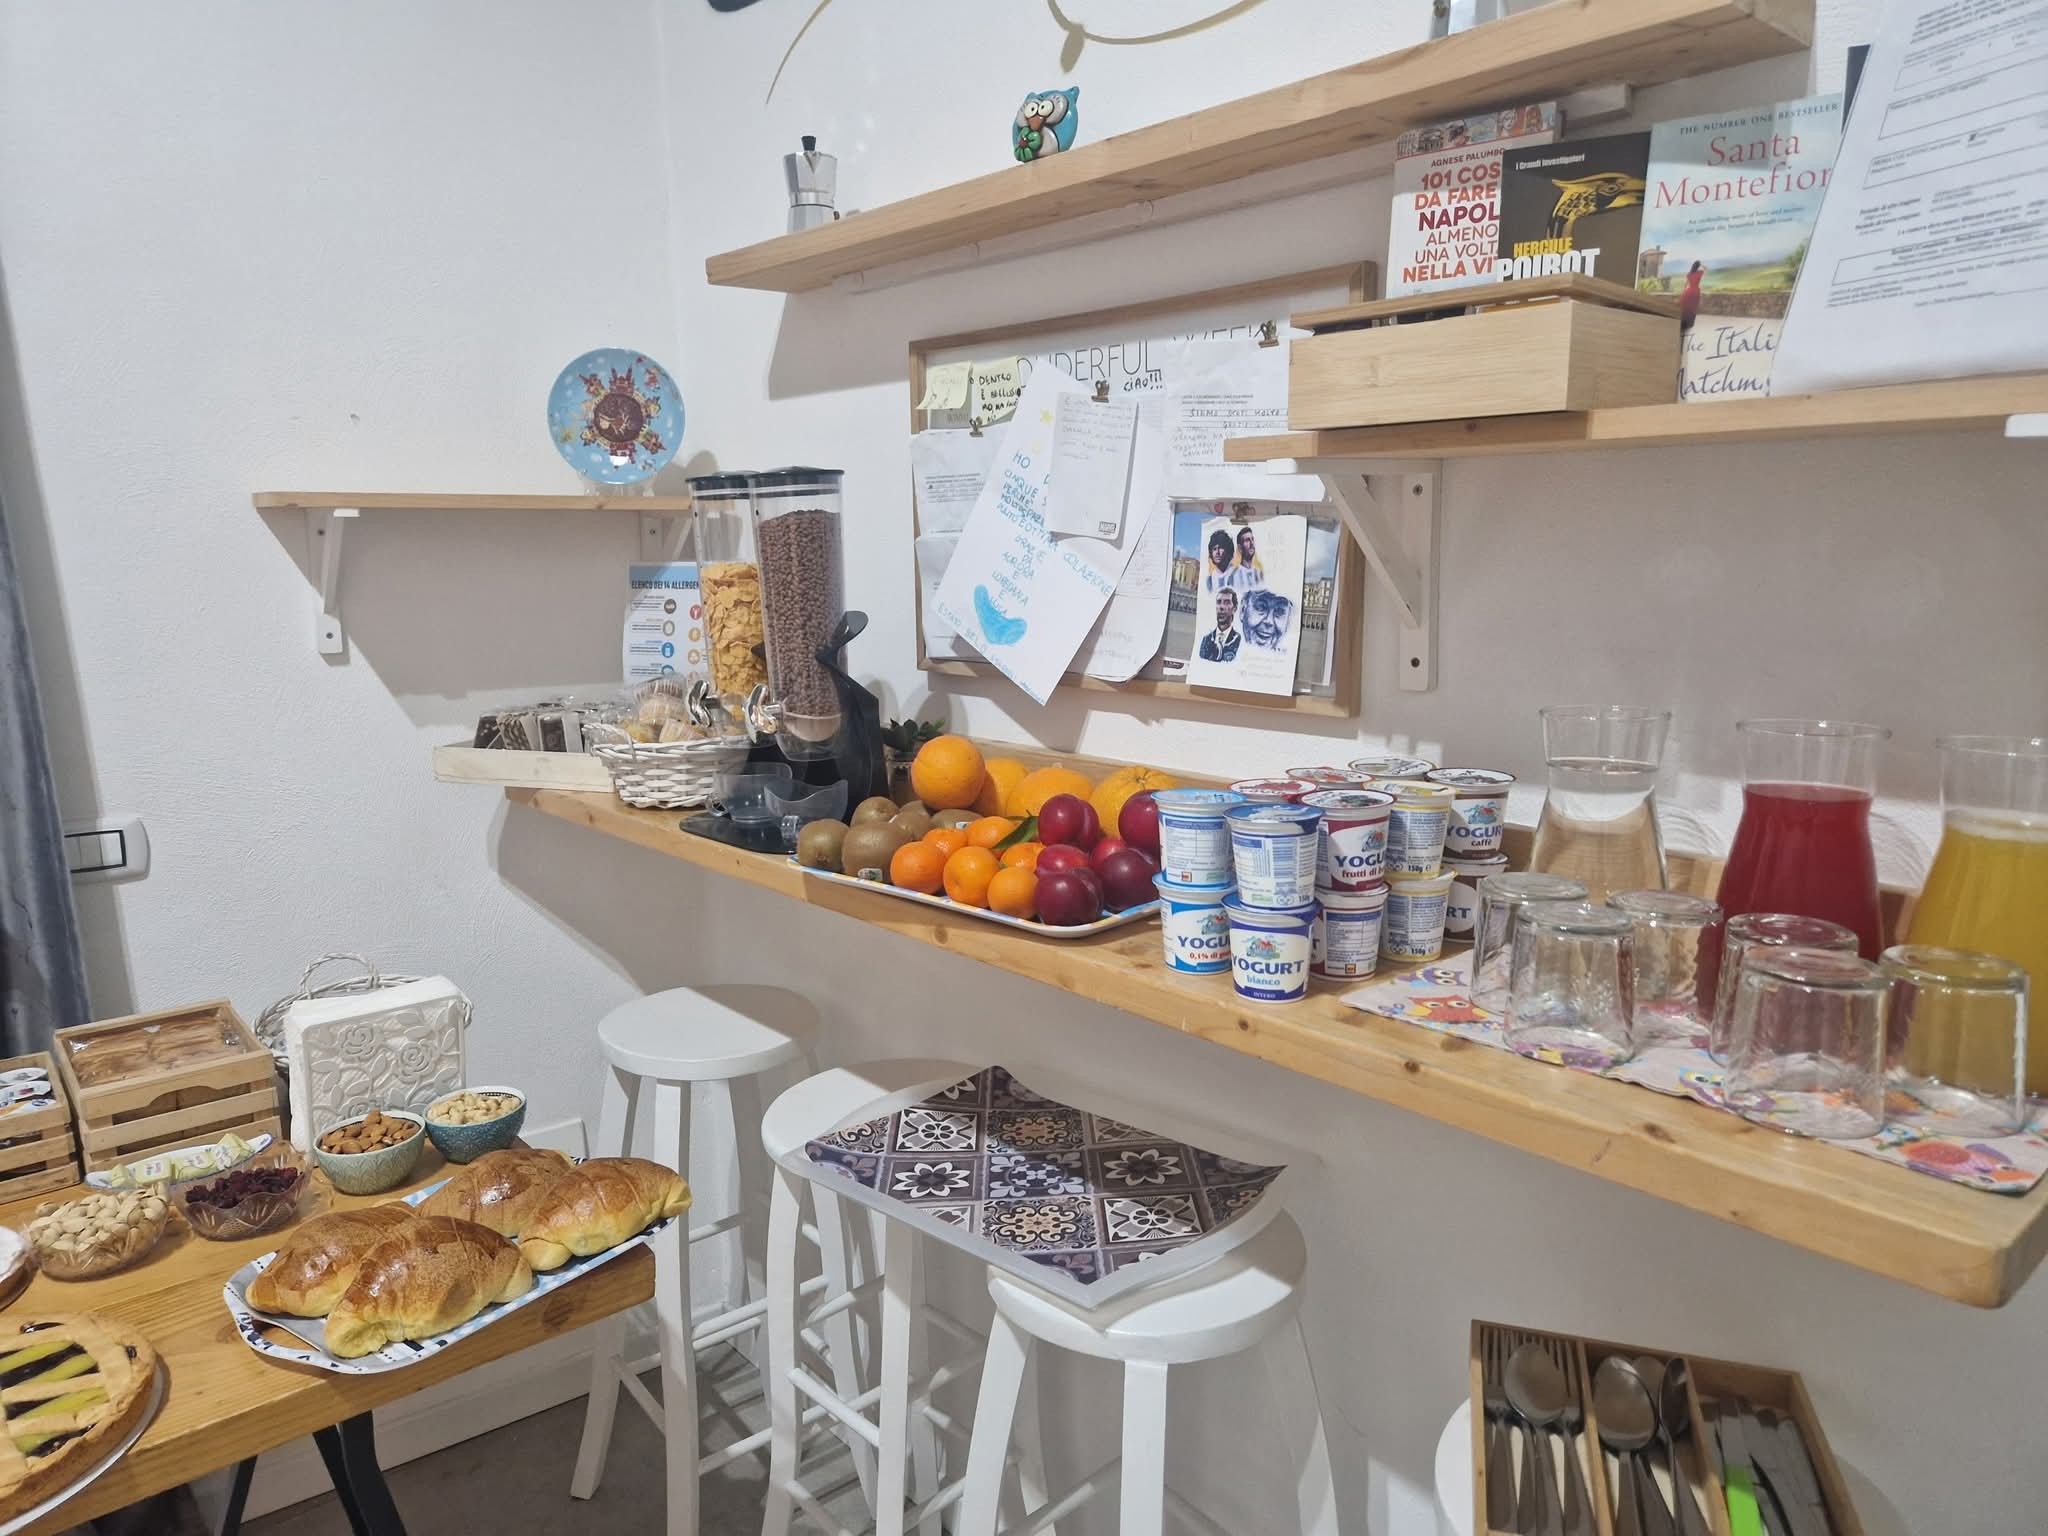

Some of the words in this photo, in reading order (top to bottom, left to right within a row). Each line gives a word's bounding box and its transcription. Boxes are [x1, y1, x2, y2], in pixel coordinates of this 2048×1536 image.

[1680, 126, 1698, 136] THE
[1703, 119, 1746, 132] NUMBER
[1751, 114, 1773, 126] ONE
[1778, 103, 1838, 120] BESTSELLER
[1431, 155, 1465, 168] AGNESE
[1707, 133, 1800, 167] Santa
[1421, 169, 1452, 191] 101
[1457, 161, 1501, 184] COS
[1655, 161, 1833, 209] Montefior
[1415, 191, 1441, 210] DA
[1448, 181, 1498, 205] FARE
[1418, 201, 1502, 231] NAPOL
[1426, 223, 1499, 247] ALMENO
[1415, 247, 1449, 264] UNA
[1450, 239, 1499, 258] VOLT
[1513, 237, 1573, 258] HERCULE
[1403, 260, 1467, 284] NELLA
[1496, 247, 1600, 283] POIROT
[1016, 337, 1162, 388] ODERFUL
[979, 373, 1012, 386] DENTRO
[1013, 450, 1031, 470] HO
[1004, 469, 1040, 499] CINQUE
[631, 580, 653, 589] ELENCO
[653, 580, 663, 589] DEI
[664, 580, 670, 589] 14
[1335, 849, 1385, 868] YOGU
[1342, 869, 1367, 879] frutti
[1369, 866, 1378, 876] di
[1177, 935, 1231, 949] YOGU
[1232, 954, 1305, 975] YOGURT
[1246, 975, 1281, 987] bianco
